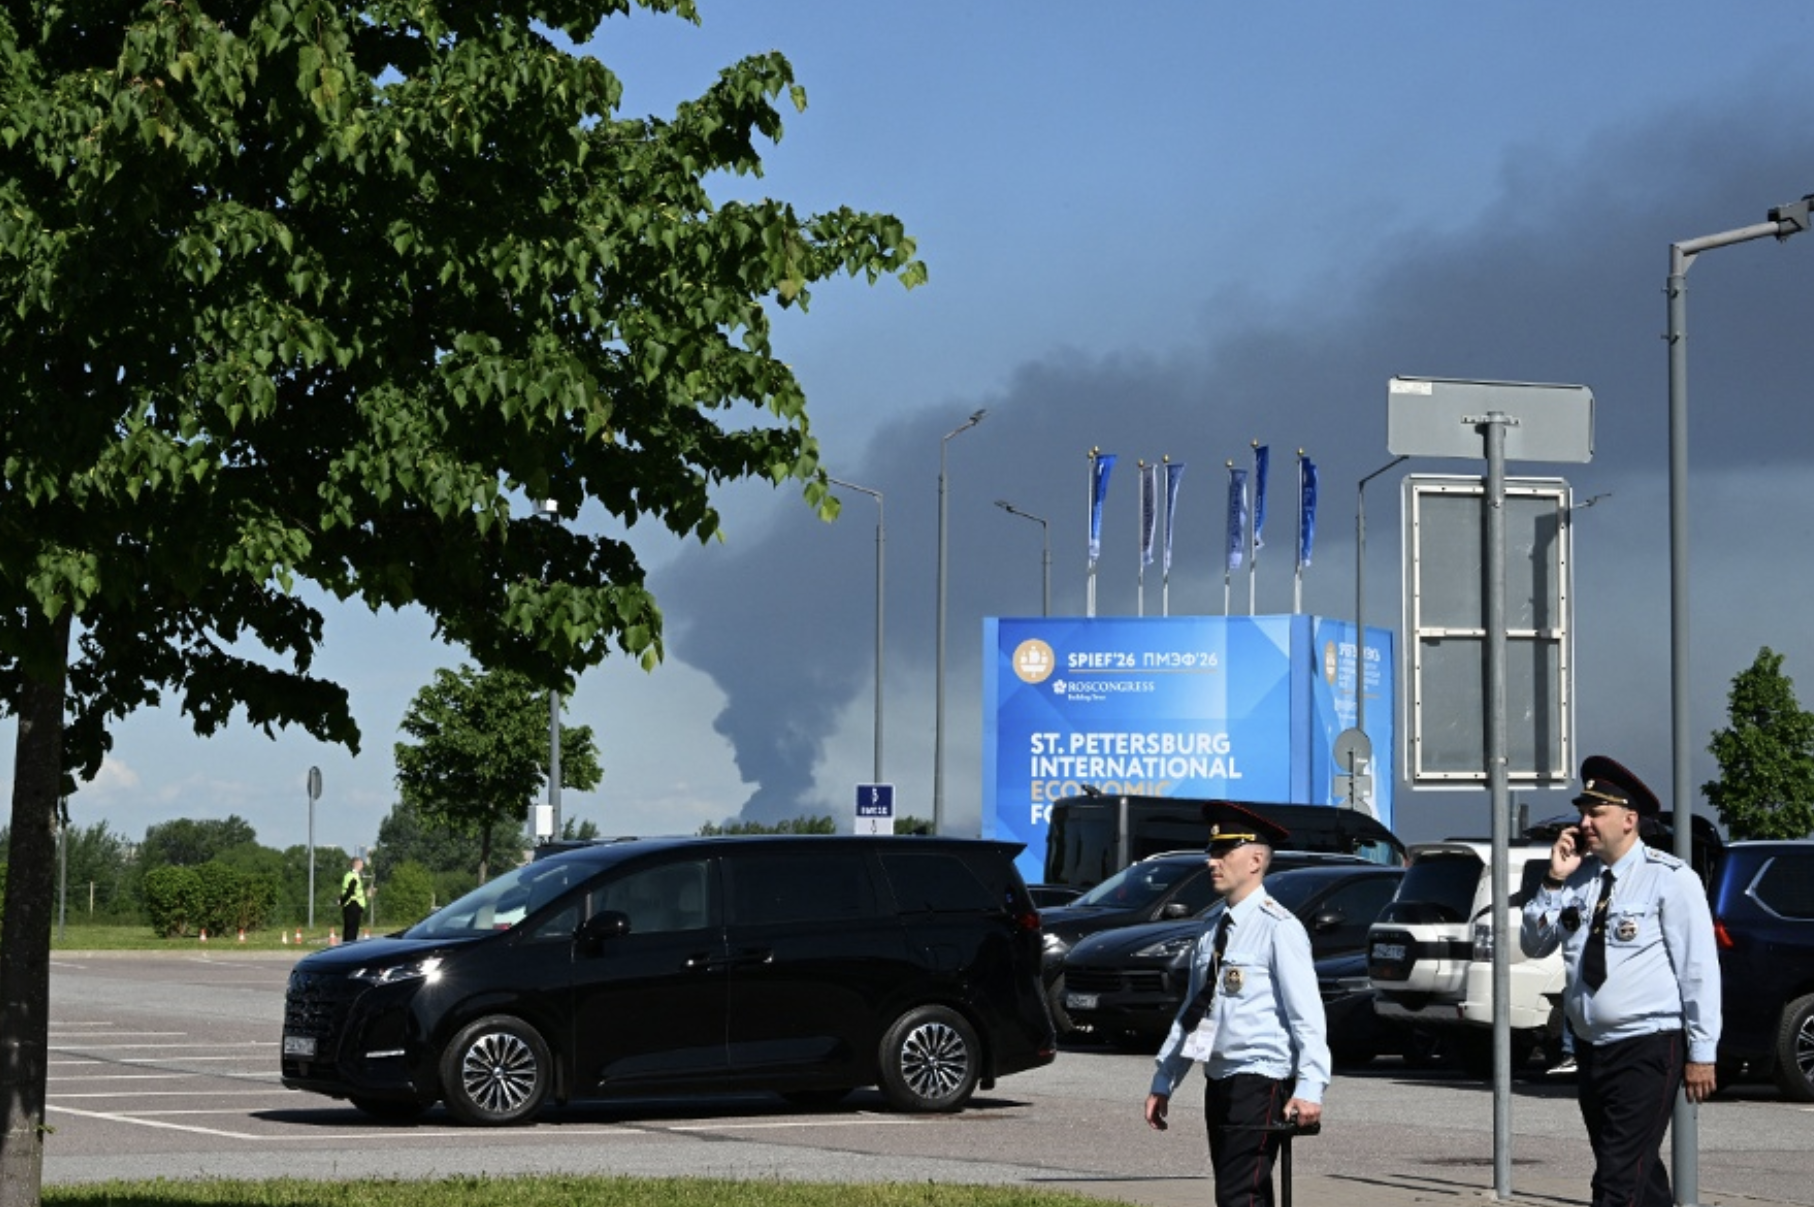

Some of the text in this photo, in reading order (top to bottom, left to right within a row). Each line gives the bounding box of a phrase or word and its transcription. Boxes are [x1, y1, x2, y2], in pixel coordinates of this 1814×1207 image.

[1068, 652, 1219, 668] SPIEF'26 ПМЭФ'26
[1068, 681, 1156, 693] ROSCONGRESS
[1031, 733, 1231, 755] ST. PETERSBURG
[1031, 756, 1243, 780] INTERNATIONAL
